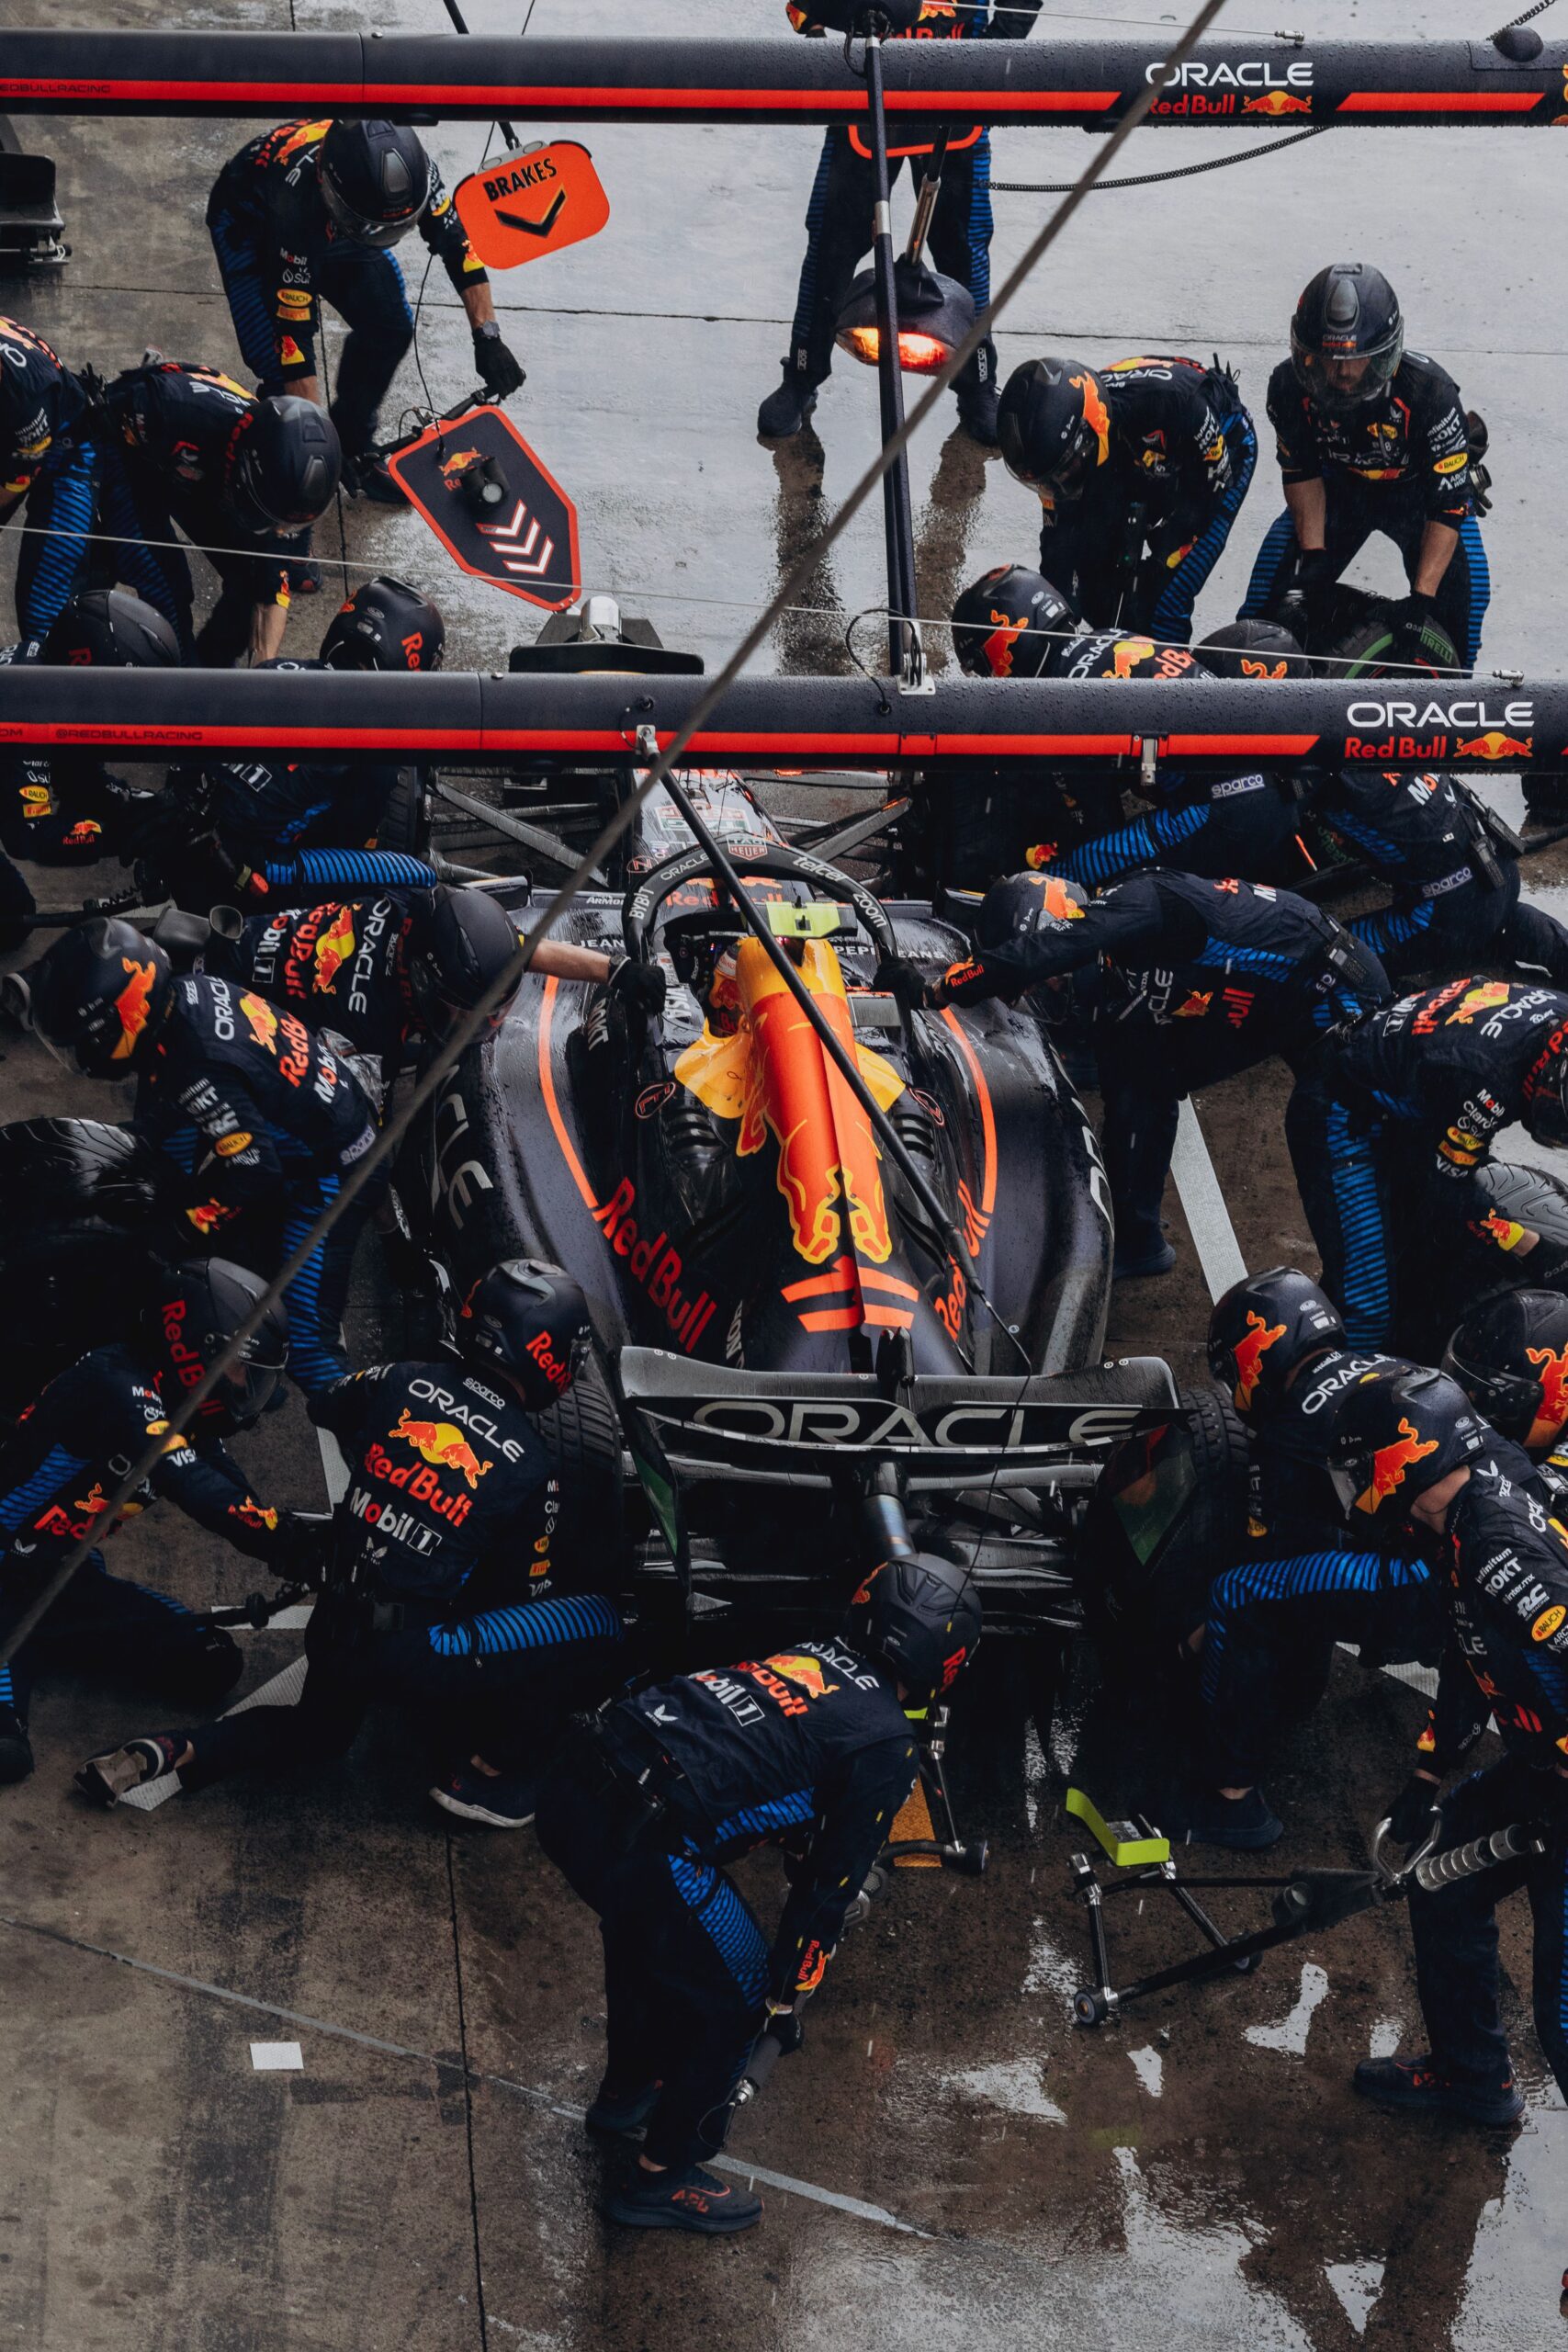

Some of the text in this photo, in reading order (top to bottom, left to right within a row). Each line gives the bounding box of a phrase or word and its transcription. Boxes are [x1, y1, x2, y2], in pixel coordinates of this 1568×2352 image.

[0, 84, 111, 93] EDBULLRACING
[1145, 62, 1314, 87] ORACLE
[482, 158, 558, 202] BRAKES
[279, 246, 308, 266] Mobil
[401, 631, 423, 672] Re
[1347, 701, 1535, 728] ORACLE
[56, 729, 202, 741] @REDBULLRACING
[28, 790, 47, 799] RAUCH
[1211, 774, 1265, 798] sparco
[660, 854, 710, 881] ORACLE
[731, 848, 767, 865] HEUER
[793, 856, 850, 882] telcel
[1421, 866, 1472, 899] sparco
[628, 886, 654, 920] BYBIT
[852, 892, 887, 928] zoom
[348, 897, 392, 1014] ORACLE
[580, 939, 626, 948] JEAN
[834, 945, 945, 959] PEP EANS
[1463, 1100, 1493, 1130] Claro
[1476, 1088, 1506, 1117] Mobil
[591, 1177, 717, 1353] Red Bull
[462, 1377, 506, 1410] sparco
[408, 1377, 525, 1463] ORACLE
[693, 1400, 1142, 1447] ORACLE
[349, 1486, 415, 1544] Mobil
[1474, 1547, 1513, 1584] infinitum
[1484, 1556, 1522, 1597] ROKT
[1538, 1609, 1562, 1633] RAUCH
